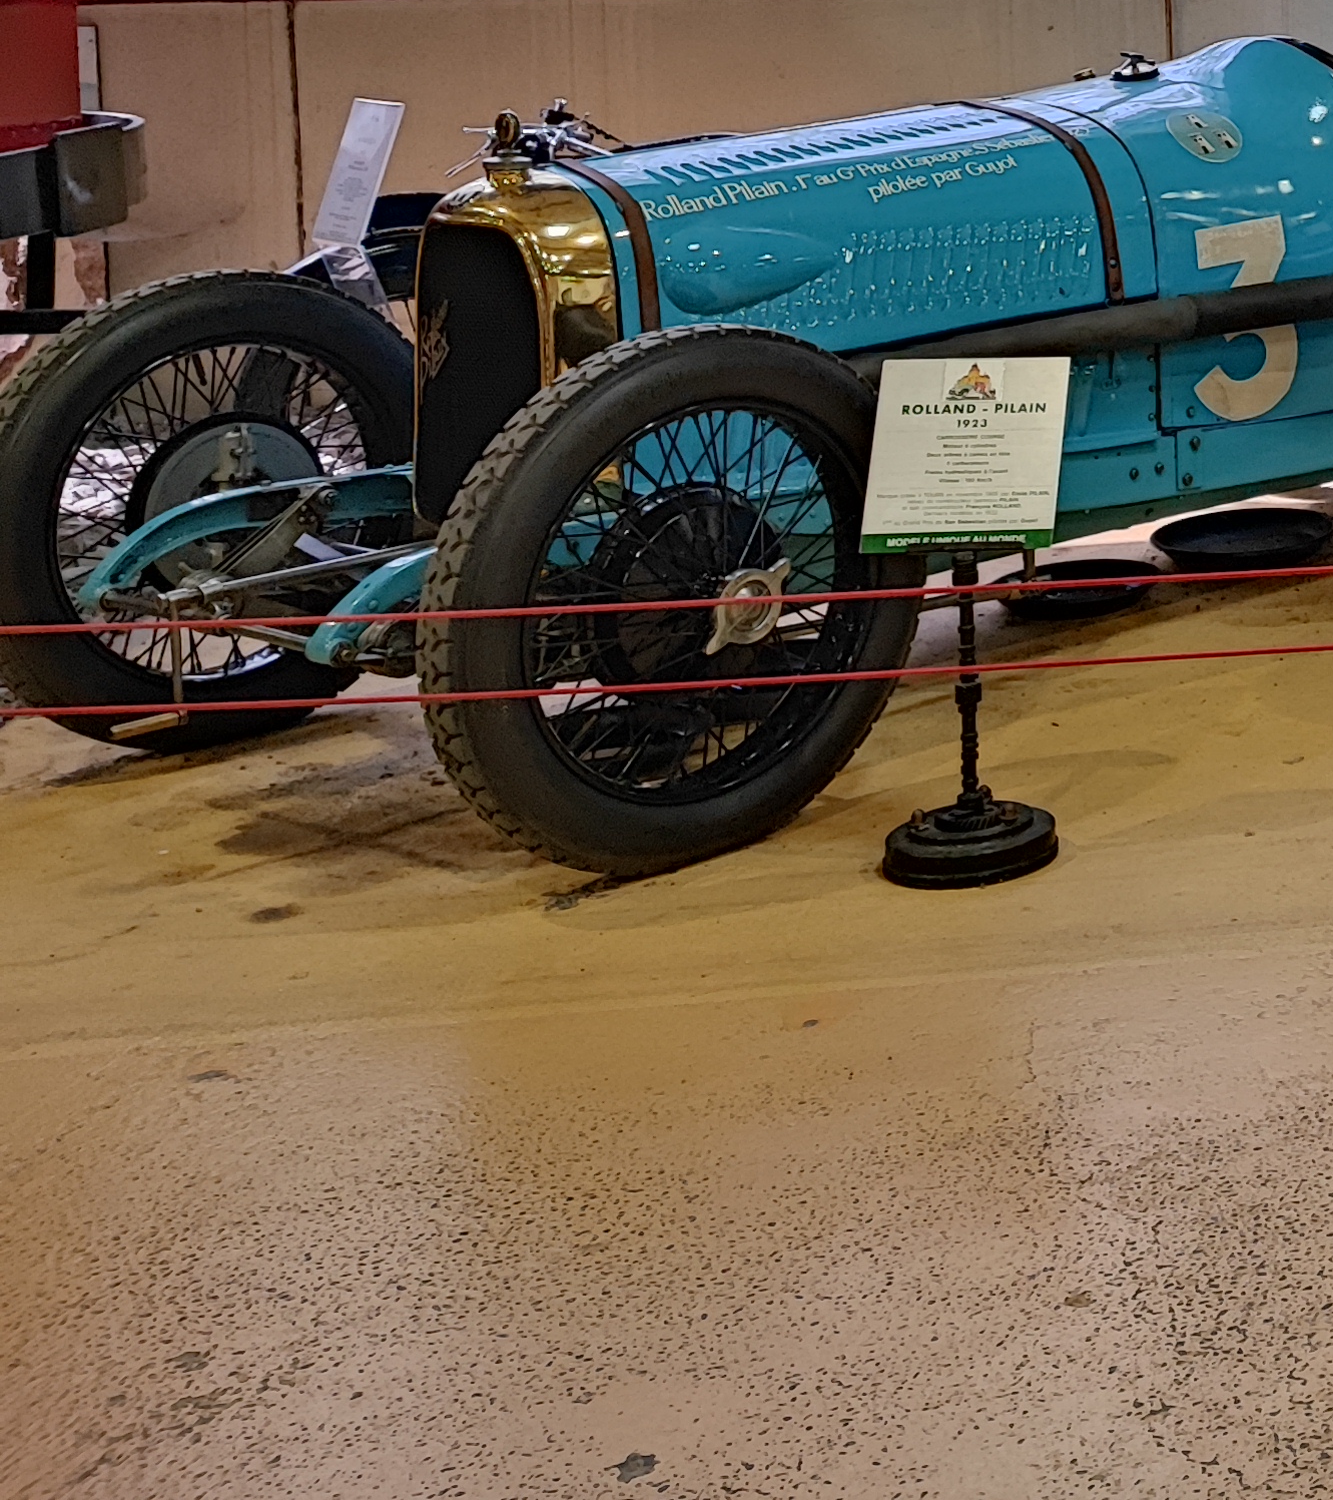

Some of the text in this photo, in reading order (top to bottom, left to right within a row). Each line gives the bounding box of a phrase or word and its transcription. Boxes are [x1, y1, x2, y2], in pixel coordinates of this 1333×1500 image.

[641, 186, 728, 221] Rolland
[722, 180, 788, 205] Pilain
[814, 172, 838, 186] au
[857, 162, 890, 178] Prix
[867, 153, 1018, 203] pilotée par Guyot
[1194, 214, 1299, 422] 3
[902, 404, 976, 415] ROLLAND
[994, 402, 1047, 414] PILAIN
[956, 419, 988, 428] 1923
